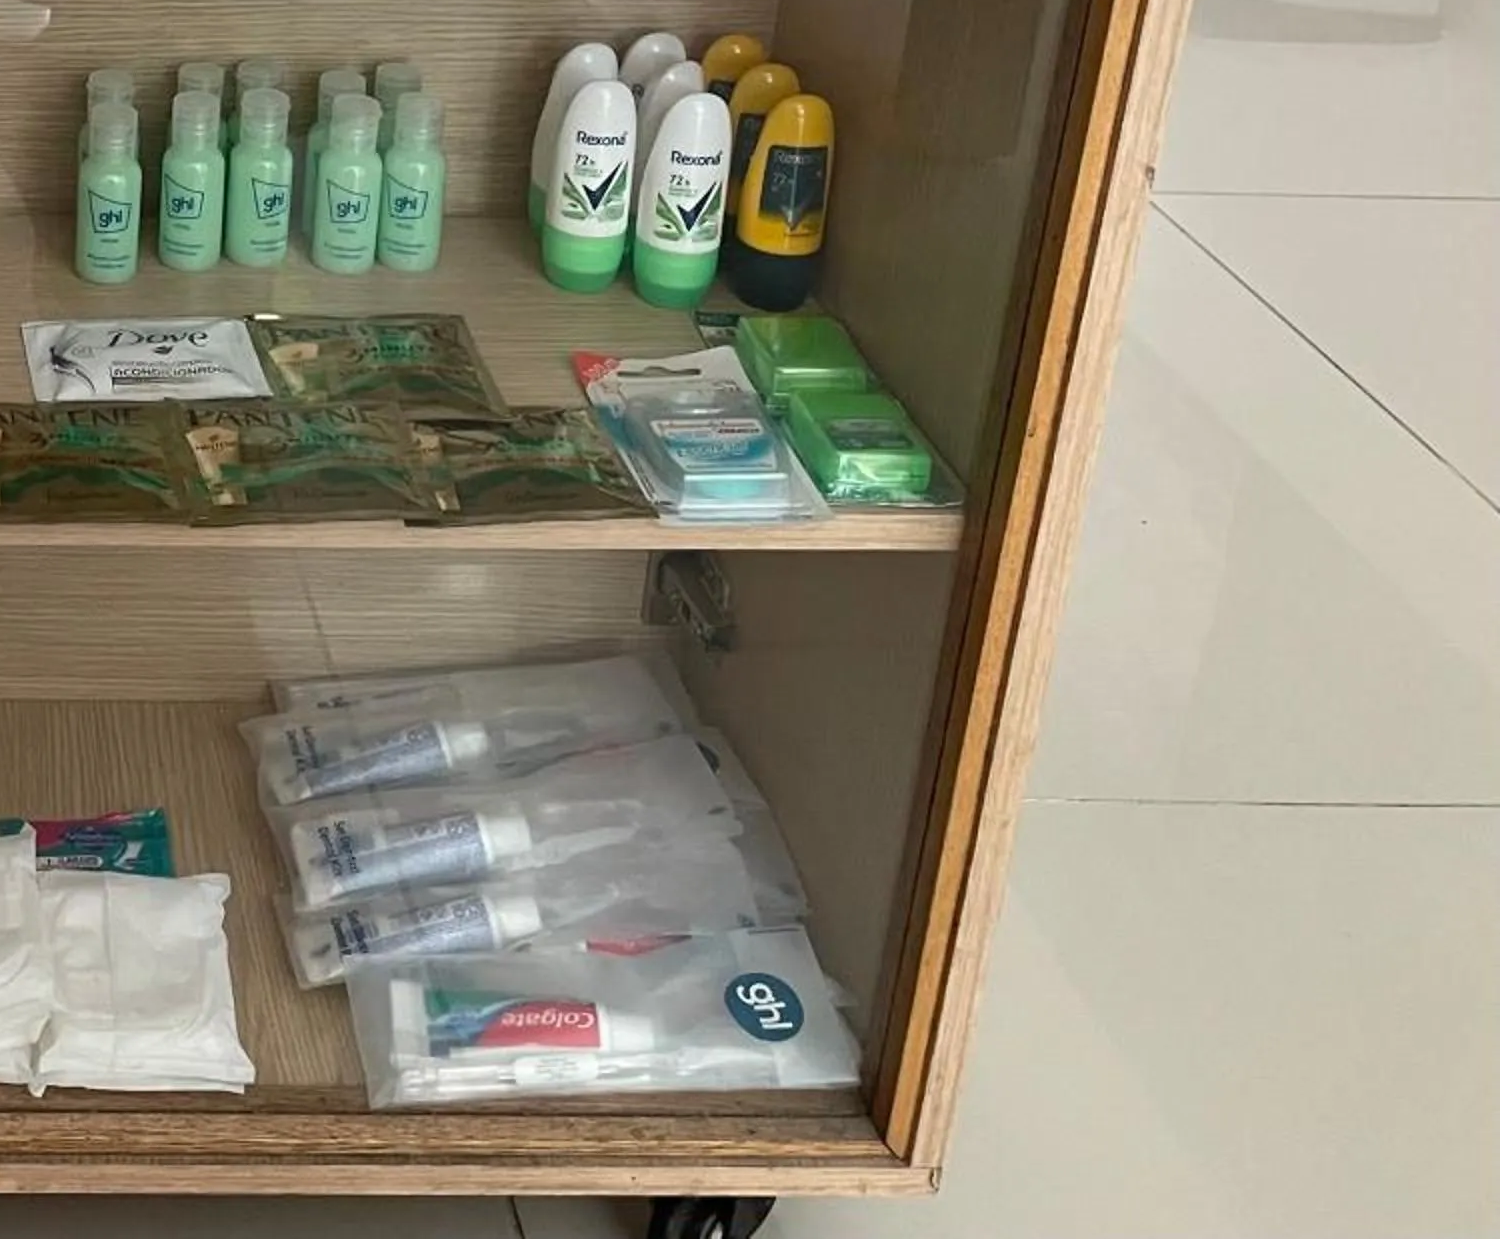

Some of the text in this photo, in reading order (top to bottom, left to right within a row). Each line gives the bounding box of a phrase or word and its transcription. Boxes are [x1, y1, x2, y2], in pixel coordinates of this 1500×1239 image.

[576, 130, 627, 147] Rexona
[671, 149, 721, 167] Rexona
[171, 196, 195, 215] ghl
[263, 194, 285, 214] ghl
[335, 200, 361, 218] ghl
[393, 195, 418, 213] ghl
[98, 209, 124, 229] ghl
[107, 328, 210, 348] Dove
[736, 982, 793, 1030] ghl
[501, 1010, 596, 1032] Colgate
